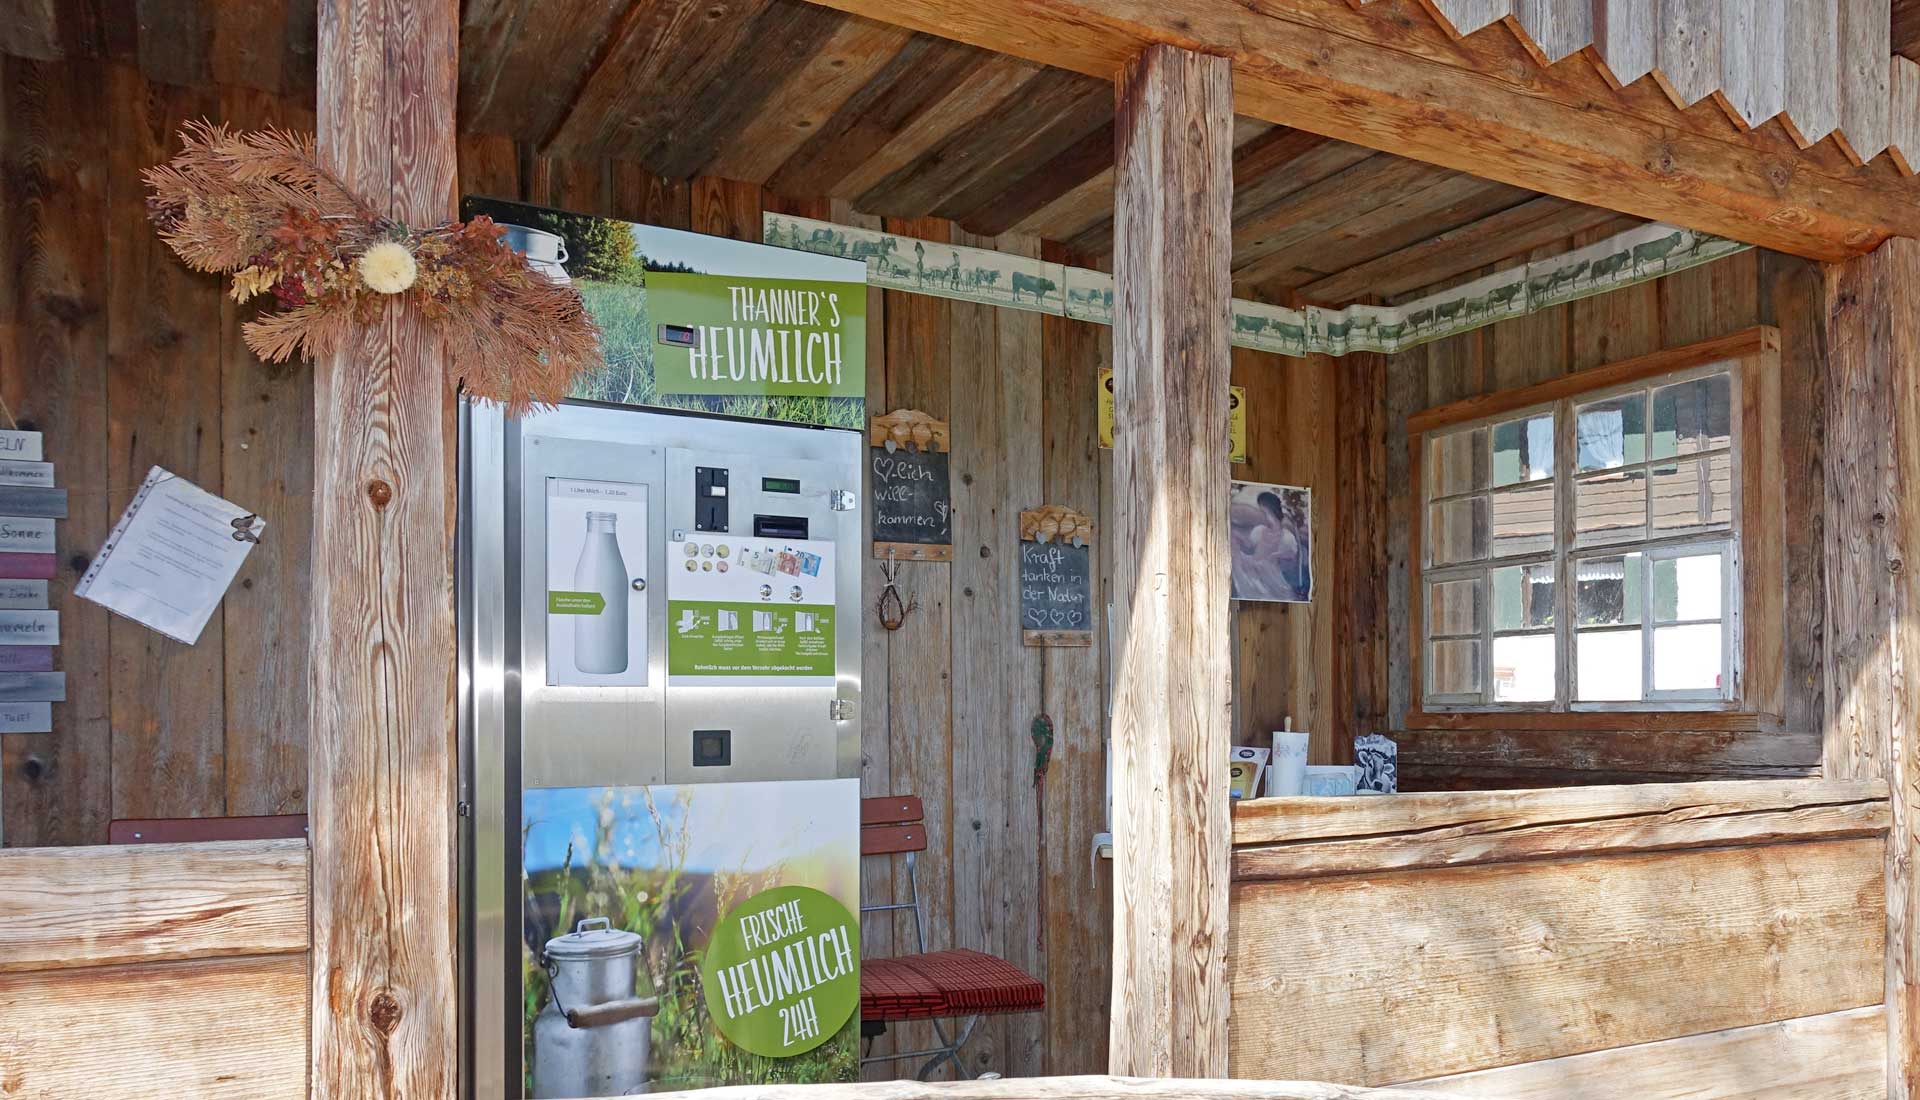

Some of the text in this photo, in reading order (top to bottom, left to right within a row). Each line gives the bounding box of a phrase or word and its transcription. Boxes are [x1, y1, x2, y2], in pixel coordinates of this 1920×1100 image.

[687, 324, 843, 385] HEUMILCH
[0, 523, 43, 539] Sonne
[878, 510, 936, 527] kommen
[1023, 544, 1065, 572] Kraft
[1022, 568, 1082, 584] tanken in
[1023, 585, 1086, 604] der Natur
[739, 898, 808, 951] FRISCHE
[716, 925, 854, 1019] HEUMILCH
[778, 996, 820, 1047] 24H
